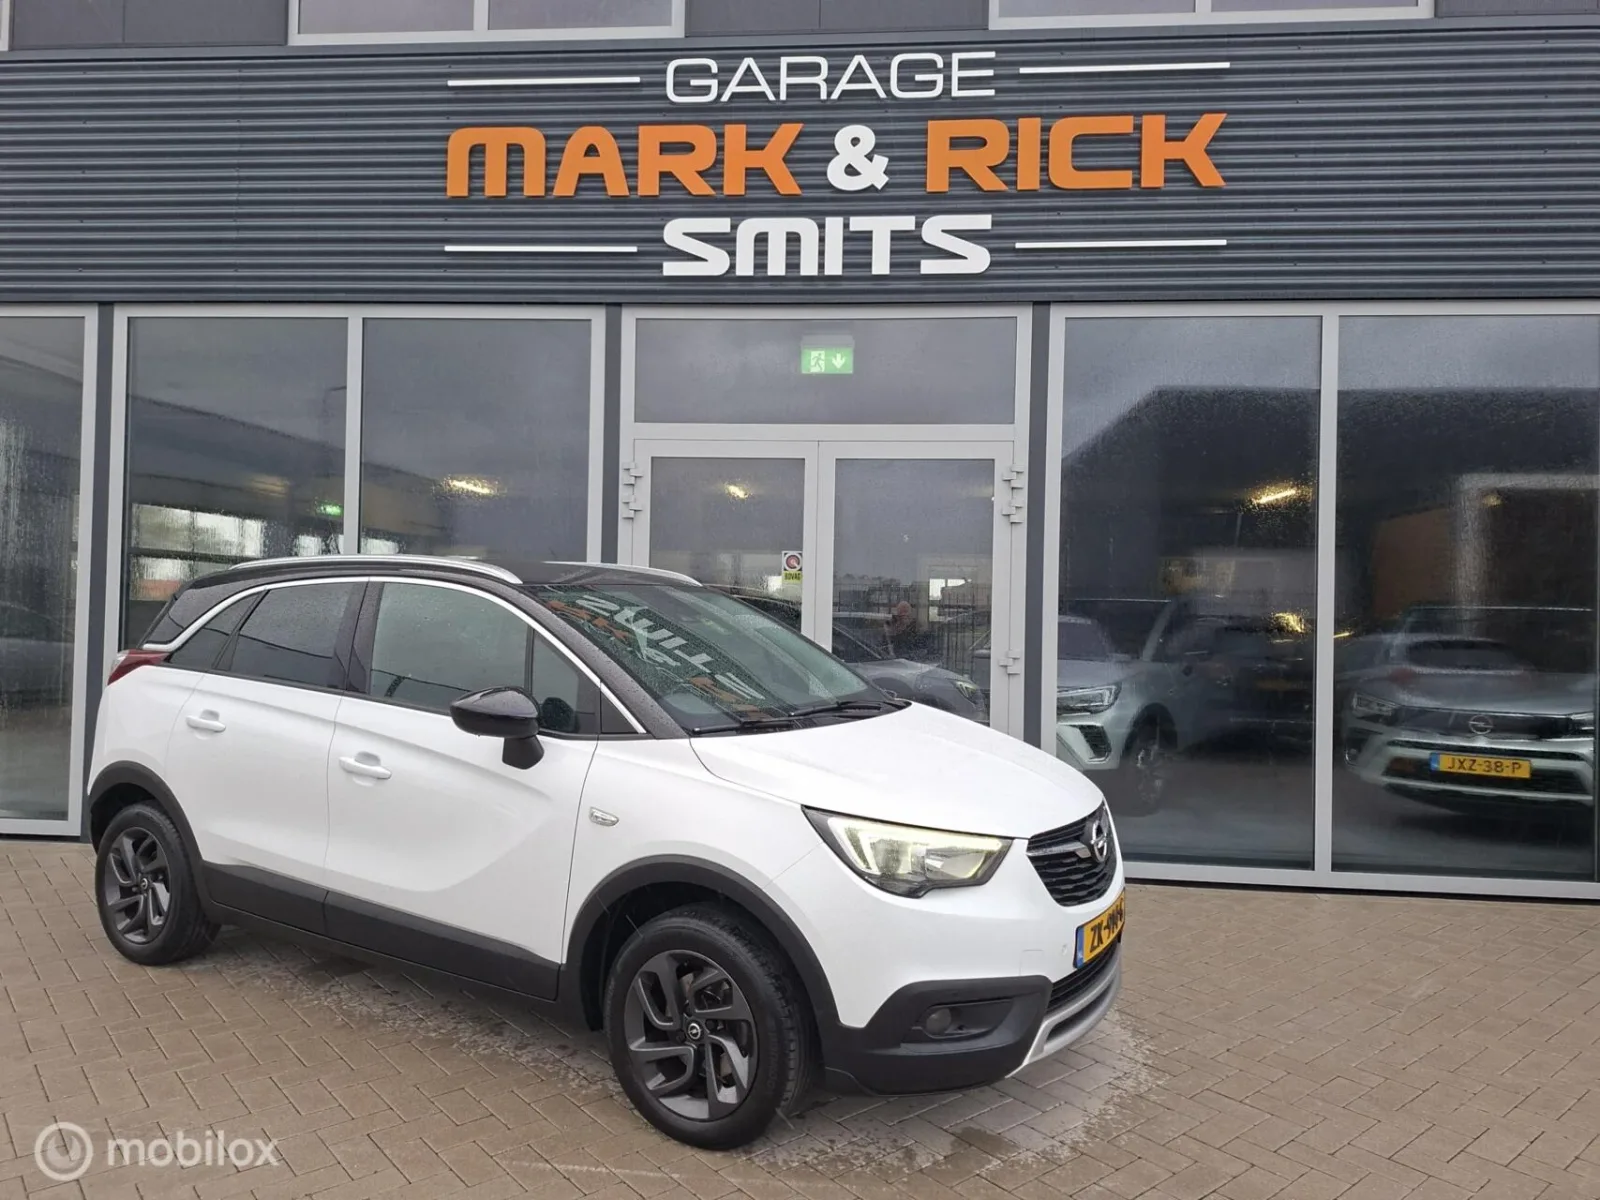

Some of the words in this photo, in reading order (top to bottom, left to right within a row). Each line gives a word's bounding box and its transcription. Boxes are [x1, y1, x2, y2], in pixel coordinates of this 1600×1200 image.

[665, 51, 996, 103] GARAGE
[446, 123, 802, 197] MARK
[827, 124, 890, 191] &
[926, 112, 1225, 192] RICK
[662, 214, 993, 276] SMITS
[1447, 757, 1522, 774] JXZ-38-P
